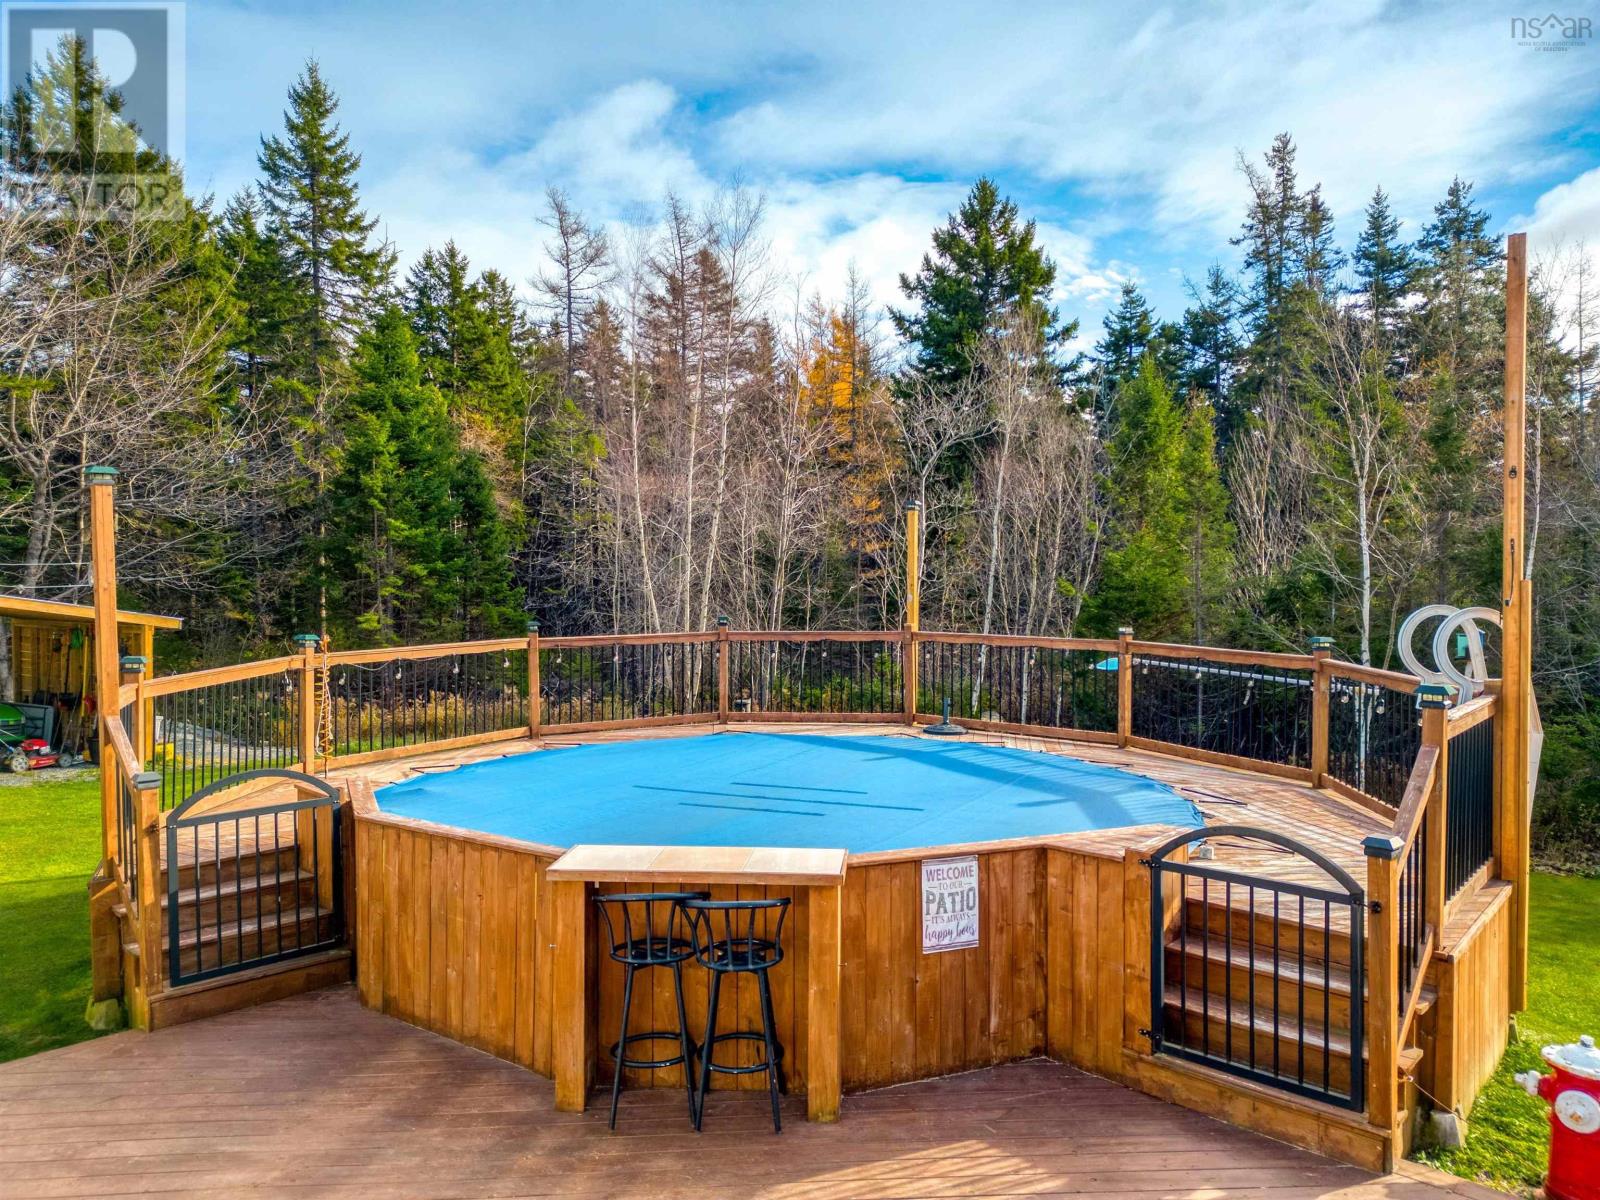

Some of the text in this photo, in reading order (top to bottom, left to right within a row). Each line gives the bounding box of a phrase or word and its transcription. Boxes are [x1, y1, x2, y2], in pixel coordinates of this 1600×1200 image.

[926, 865, 974, 882] WELCOME
[939, 881, 964, 891] TO OUR
[925, 887, 976, 916] PATIO
[925, 925, 953, 942] happy
